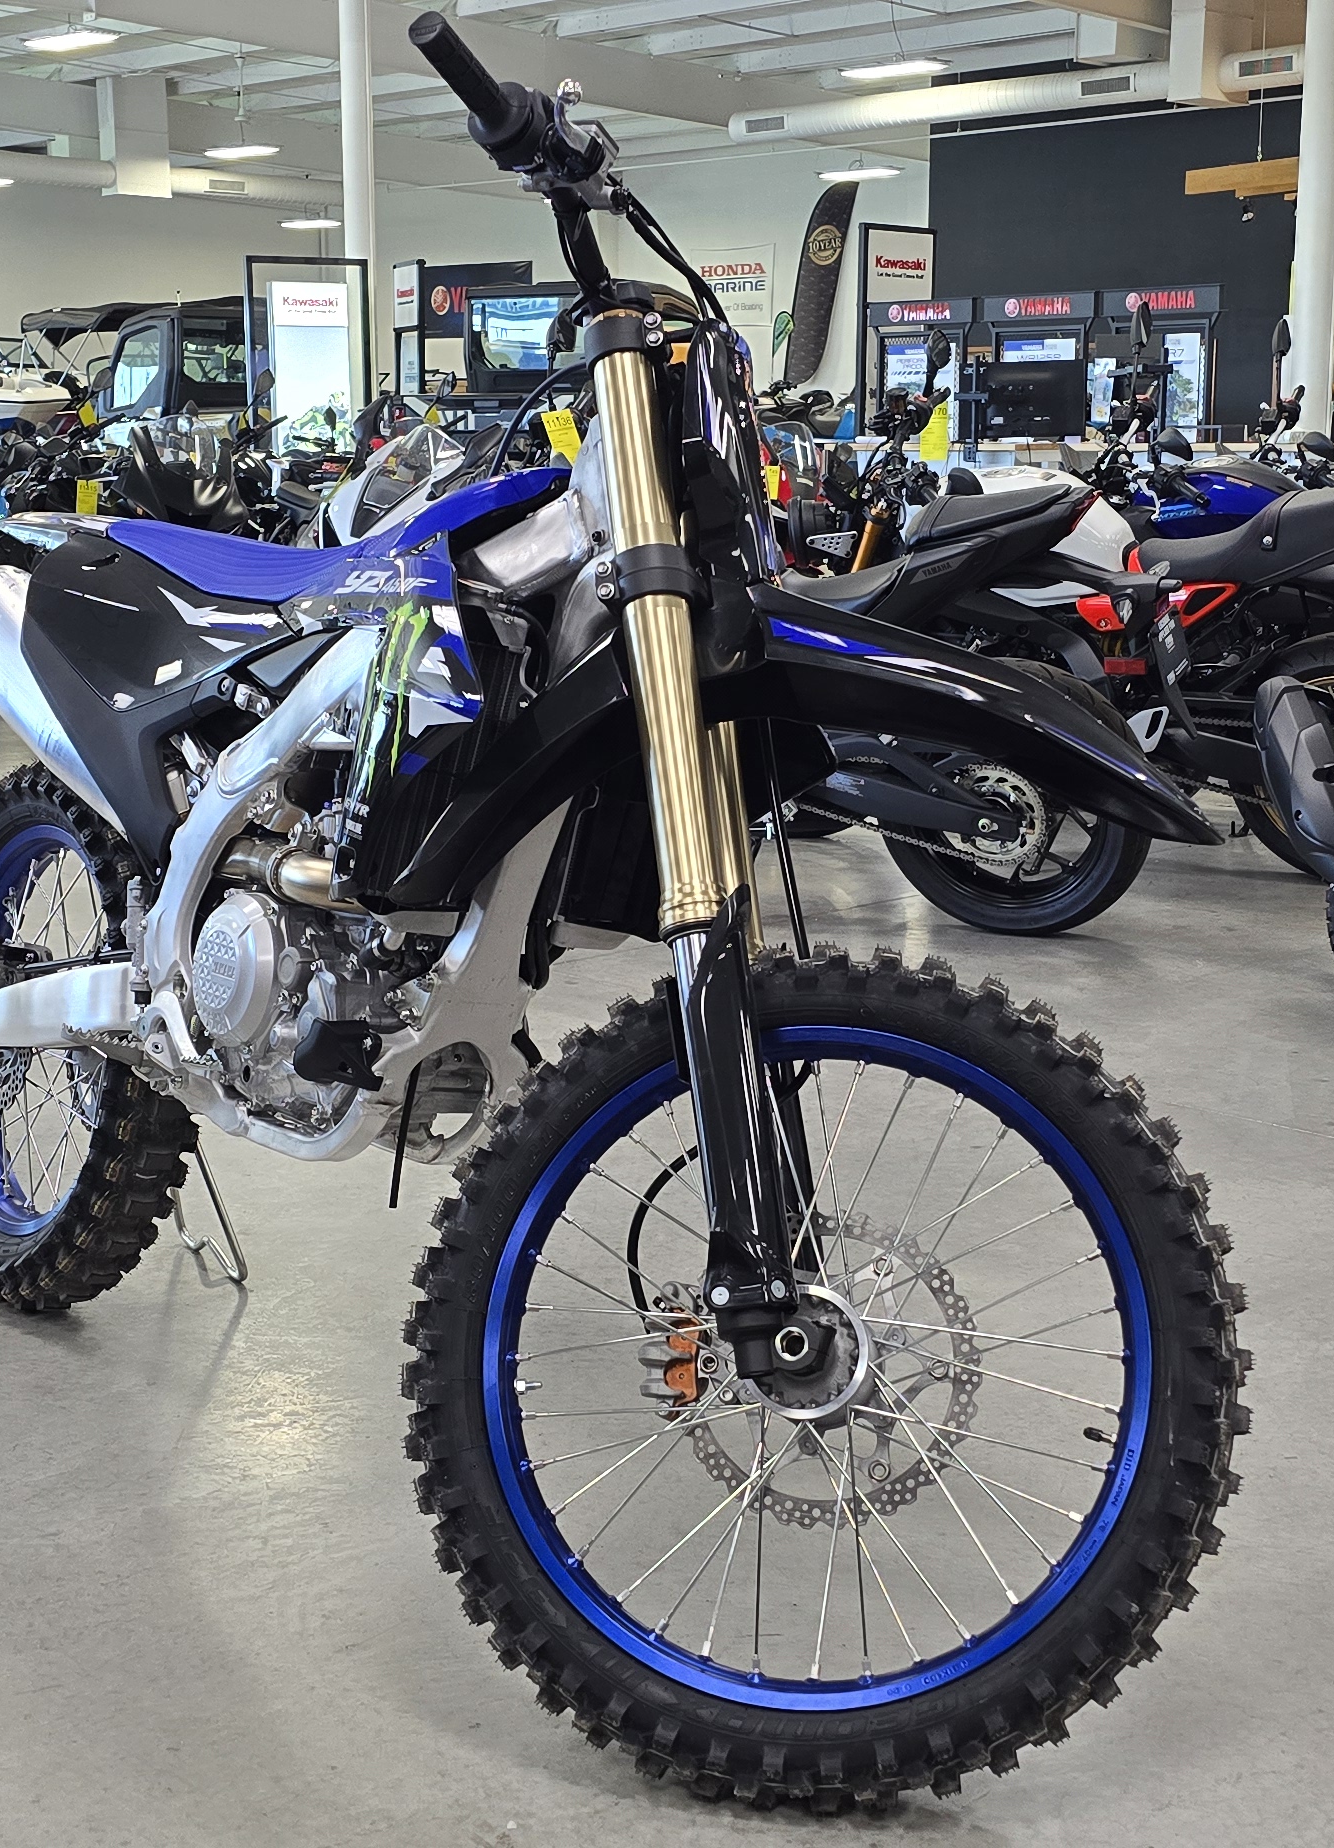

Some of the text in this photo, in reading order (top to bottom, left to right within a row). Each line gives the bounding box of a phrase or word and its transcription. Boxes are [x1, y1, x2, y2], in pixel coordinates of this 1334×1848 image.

[808, 237, 842, 253] 10 YEAR
[700, 262, 766, 277] HONDA
[875, 255, 927, 271] Kawasaki
[282, 296, 339, 307] Kawasaki
[1019, 296, 1071, 316] YAMAHA
[1141, 290, 1195, 310] YAMAHA
[902, 303, 951, 321] YAMAHA
[922, 562, 952, 577] YAMAHA
